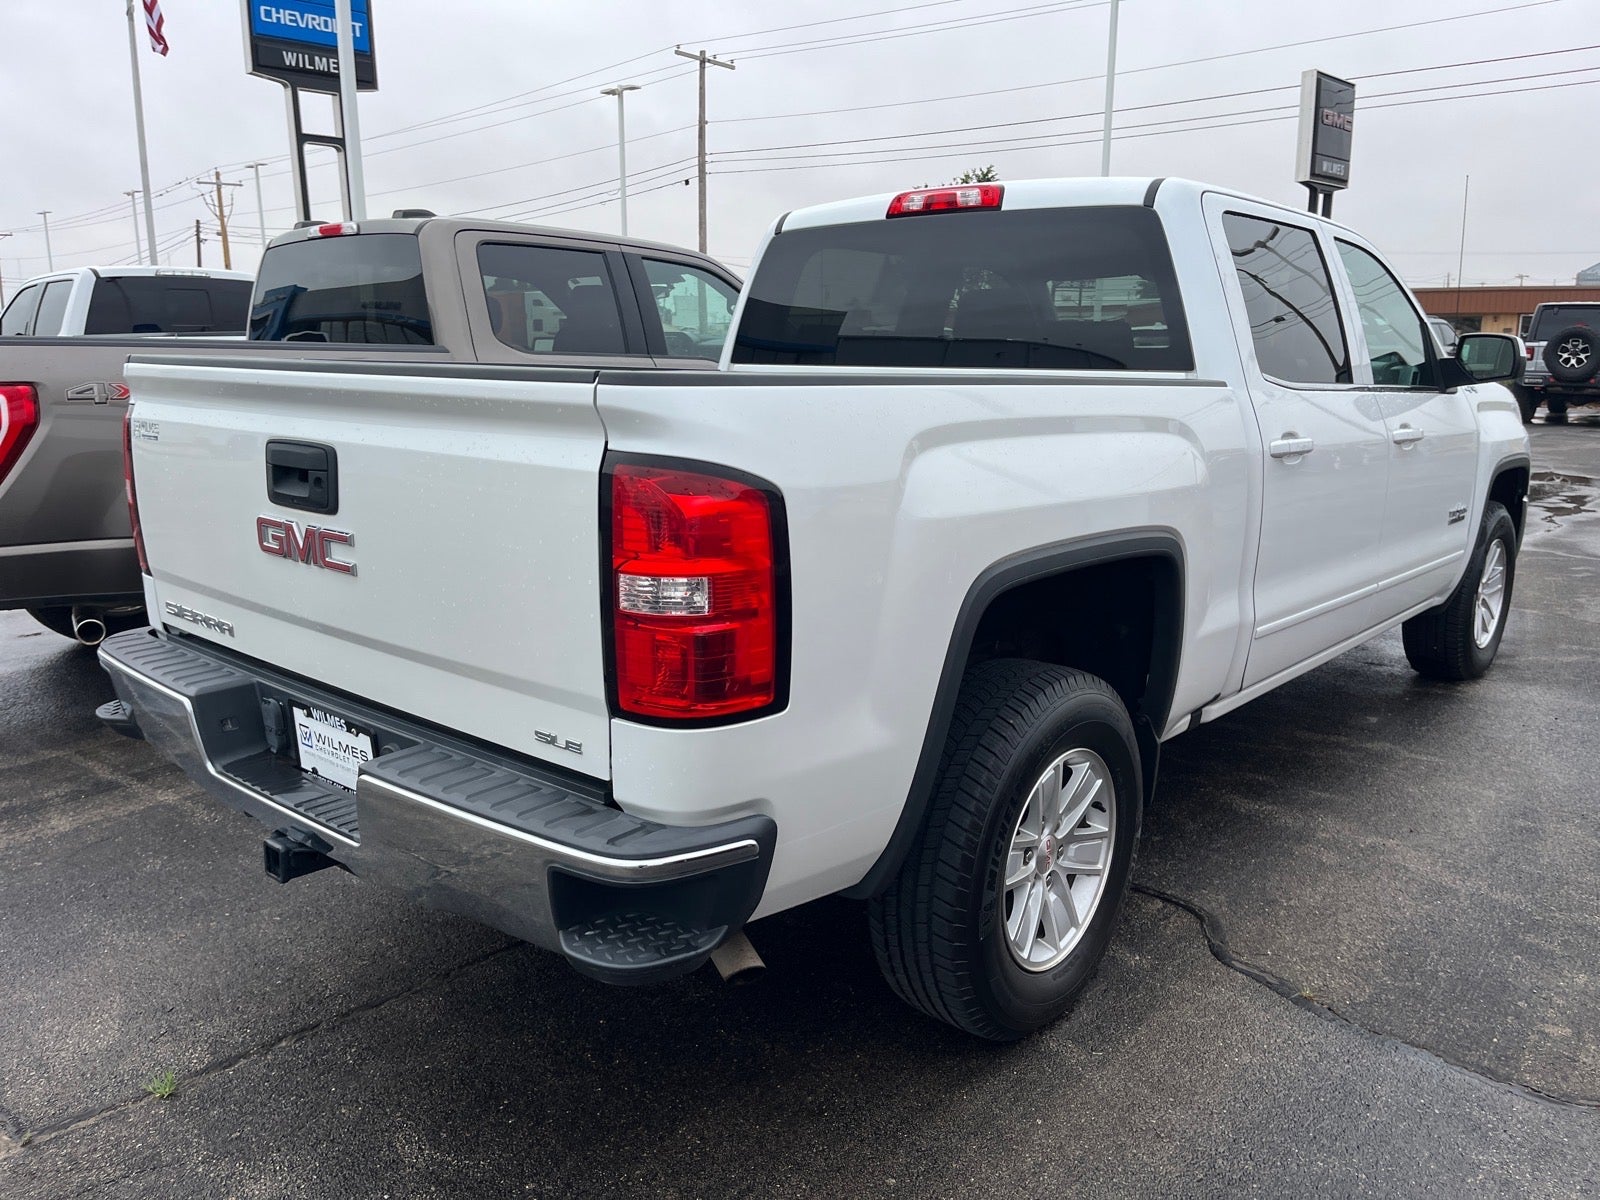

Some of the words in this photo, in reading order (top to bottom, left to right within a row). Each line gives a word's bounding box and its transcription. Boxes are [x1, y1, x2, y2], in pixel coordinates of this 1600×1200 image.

[260, 5, 362, 37] CHEVROLT
[282, 50, 340, 74] WILME
[1322, 109, 1353, 131] GMC
[256, 515, 357, 577] GMC
[165, 600, 235, 638] SIERRA
[310, 707, 347, 732] WILMES
[314, 731, 368, 762] WILMES
[315, 745, 350, 763] CHEVROLET
[534, 729, 583, 756] SLE
